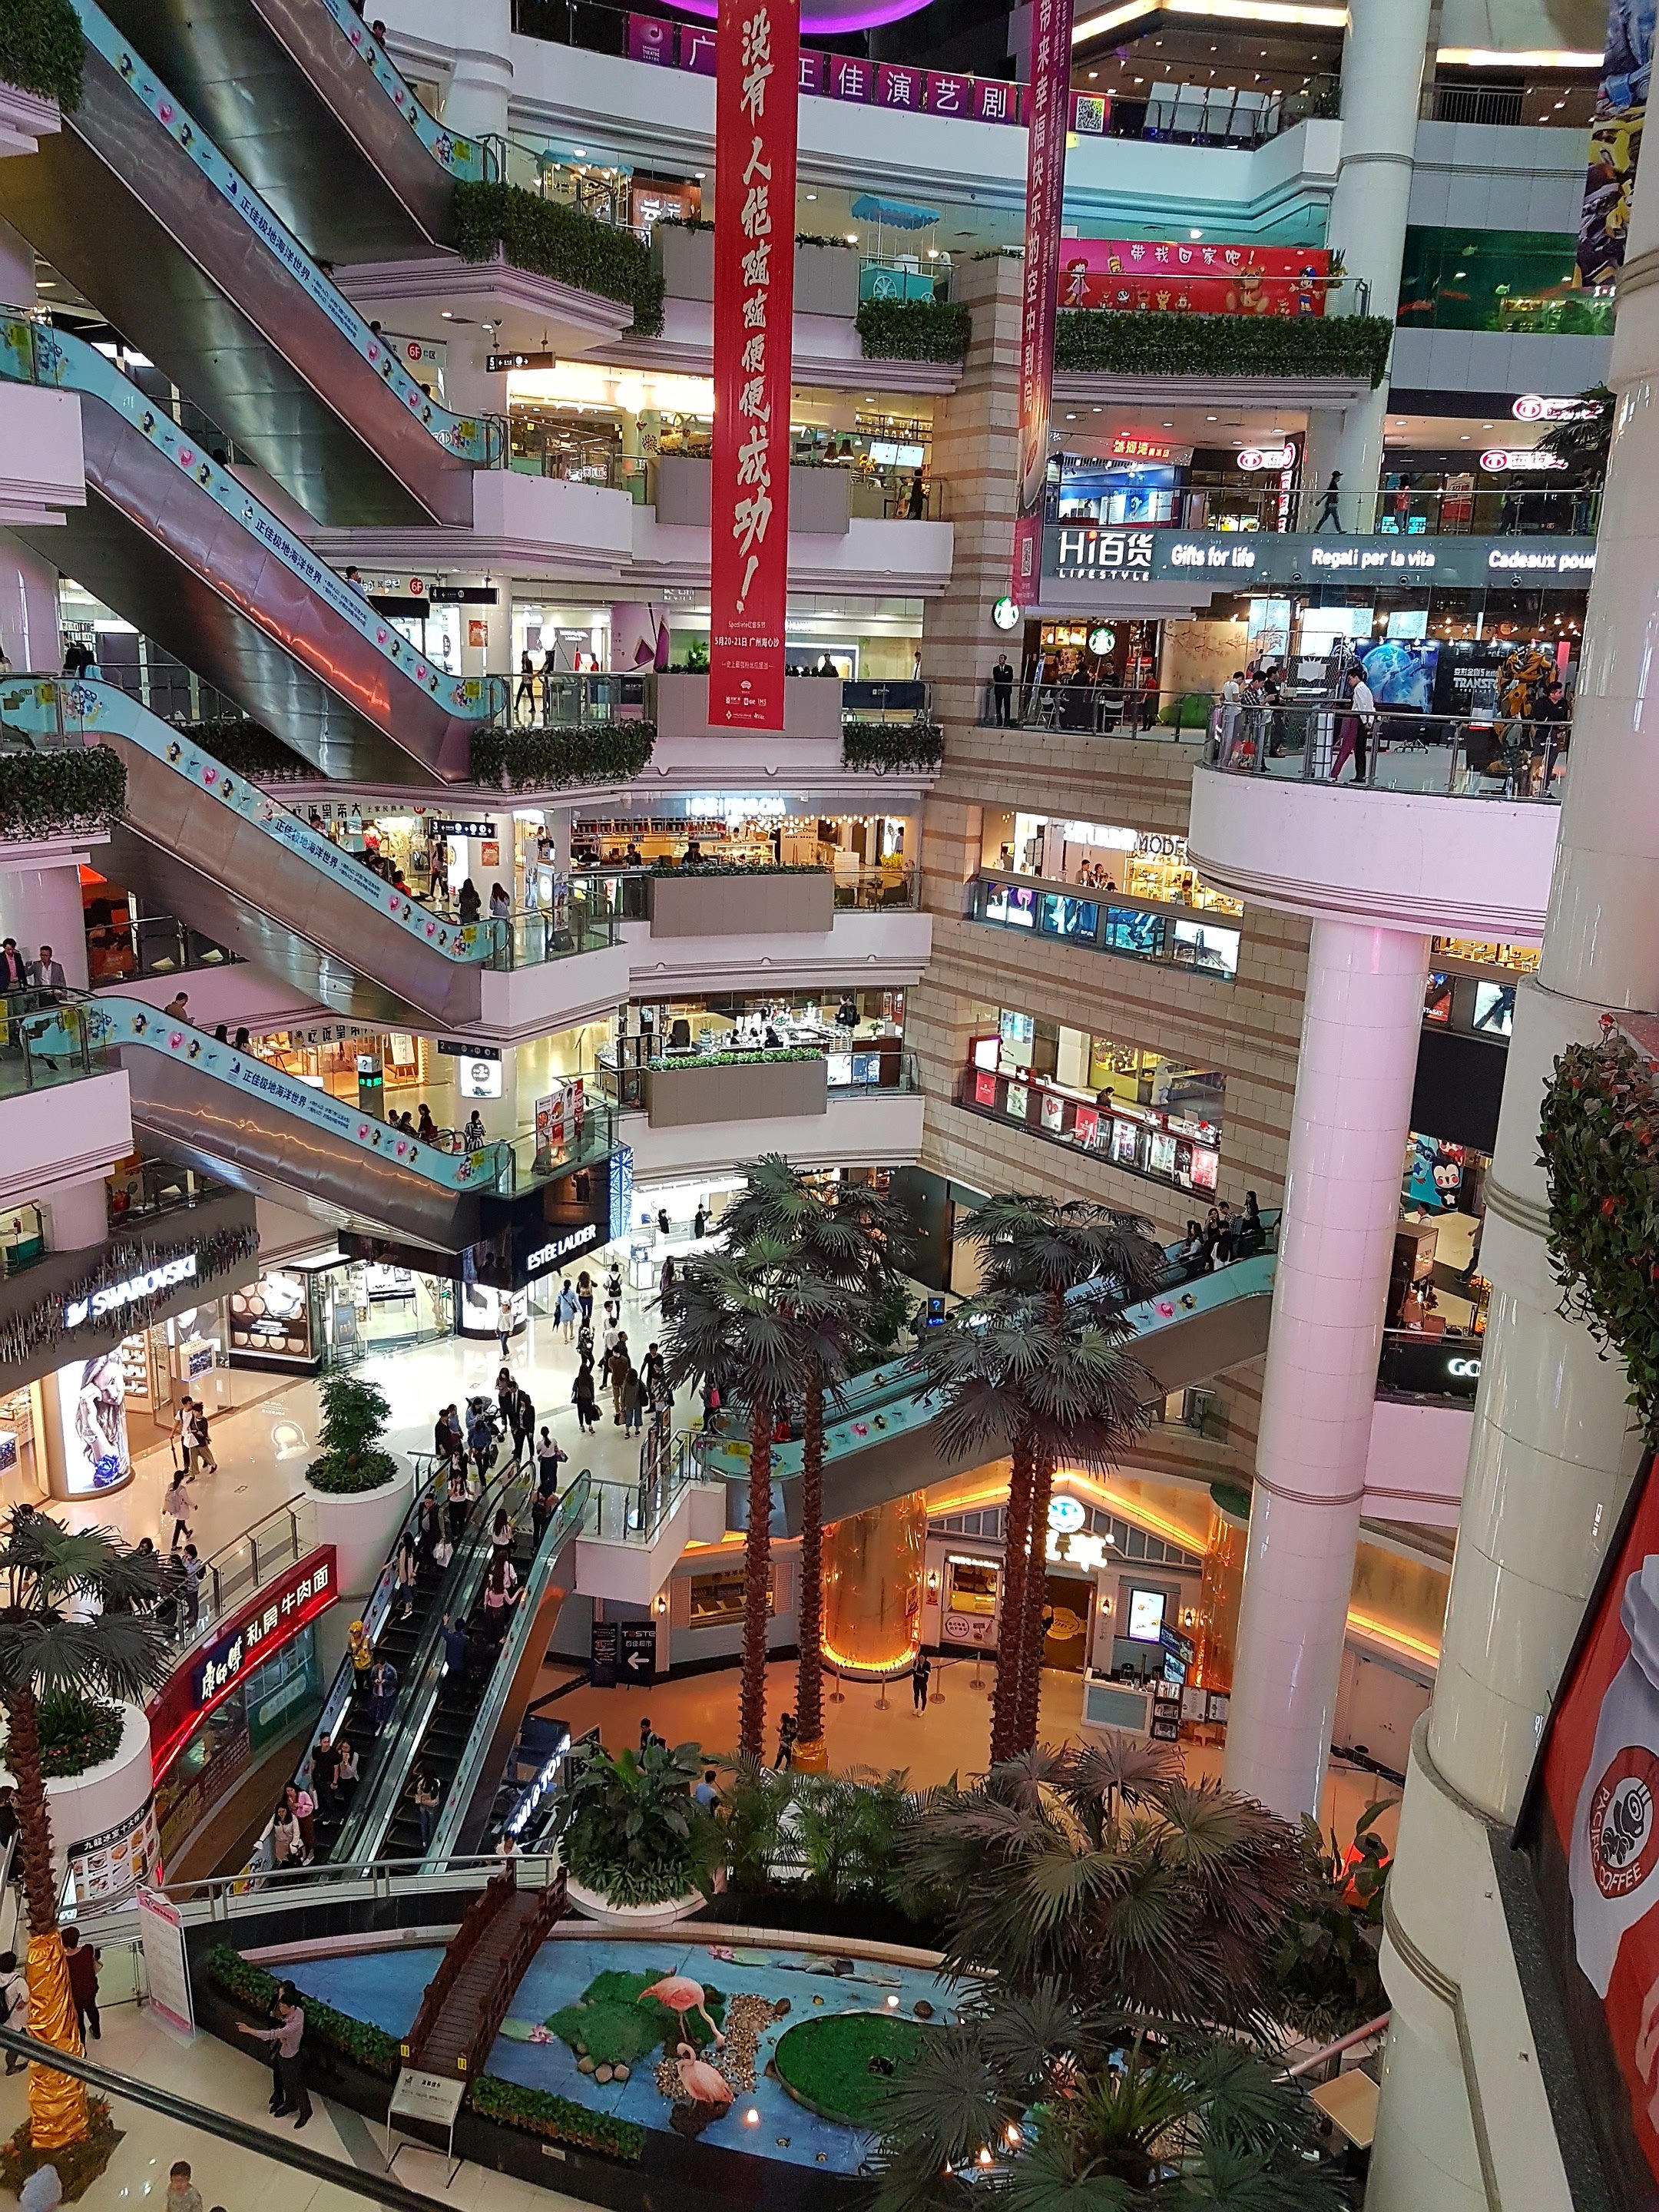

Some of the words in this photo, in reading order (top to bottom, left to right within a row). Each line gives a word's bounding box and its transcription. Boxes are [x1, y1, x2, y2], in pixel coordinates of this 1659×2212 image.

[240, 196, 311, 282] 正佳极地海洋世界
[1131, 243, 1255, 266] 带我回家吧！
[409, 346, 422, 358] 6F
[489, 356, 495, 366] 5
[255, 518, 323, 584] 正佳极地海洋世界
[1059, 530, 1154, 567] Hi百货
[1171, 544, 1205, 566] Gifts
[1207, 545, 1230, 567] for
[1232, 546, 1256, 568] life
[1312, 548, 1359, 568] Regali
[1362, 551, 1387, 569] per
[1391, 549, 1406, 567] la
[1408, 550, 1435, 567] vita
[1488, 551, 1556, 570] Cadeaux
[411, 581, 422, 592] 6F
[1059, 568, 1150, 581] LIFESTYLE
[432, 588, 438, 598] 4
[748, 637, 780, 648] 广州海心沙
[432, 821, 439, 830] 3
[275, 819, 339, 869] 正佳极地海洋世界
[242, 1068, 307, 1108] 正佳极地海洋世界
[558, 1224, 596, 1255] LAUDER
[92, 1254, 197, 1316] SWAROVSKI
[246, 1564, 328, 1647] 私房牛肉面
[1591, 1786, 1611, 1869] PACIFIC
[1599, 1862, 1642, 1892] COFFEE
